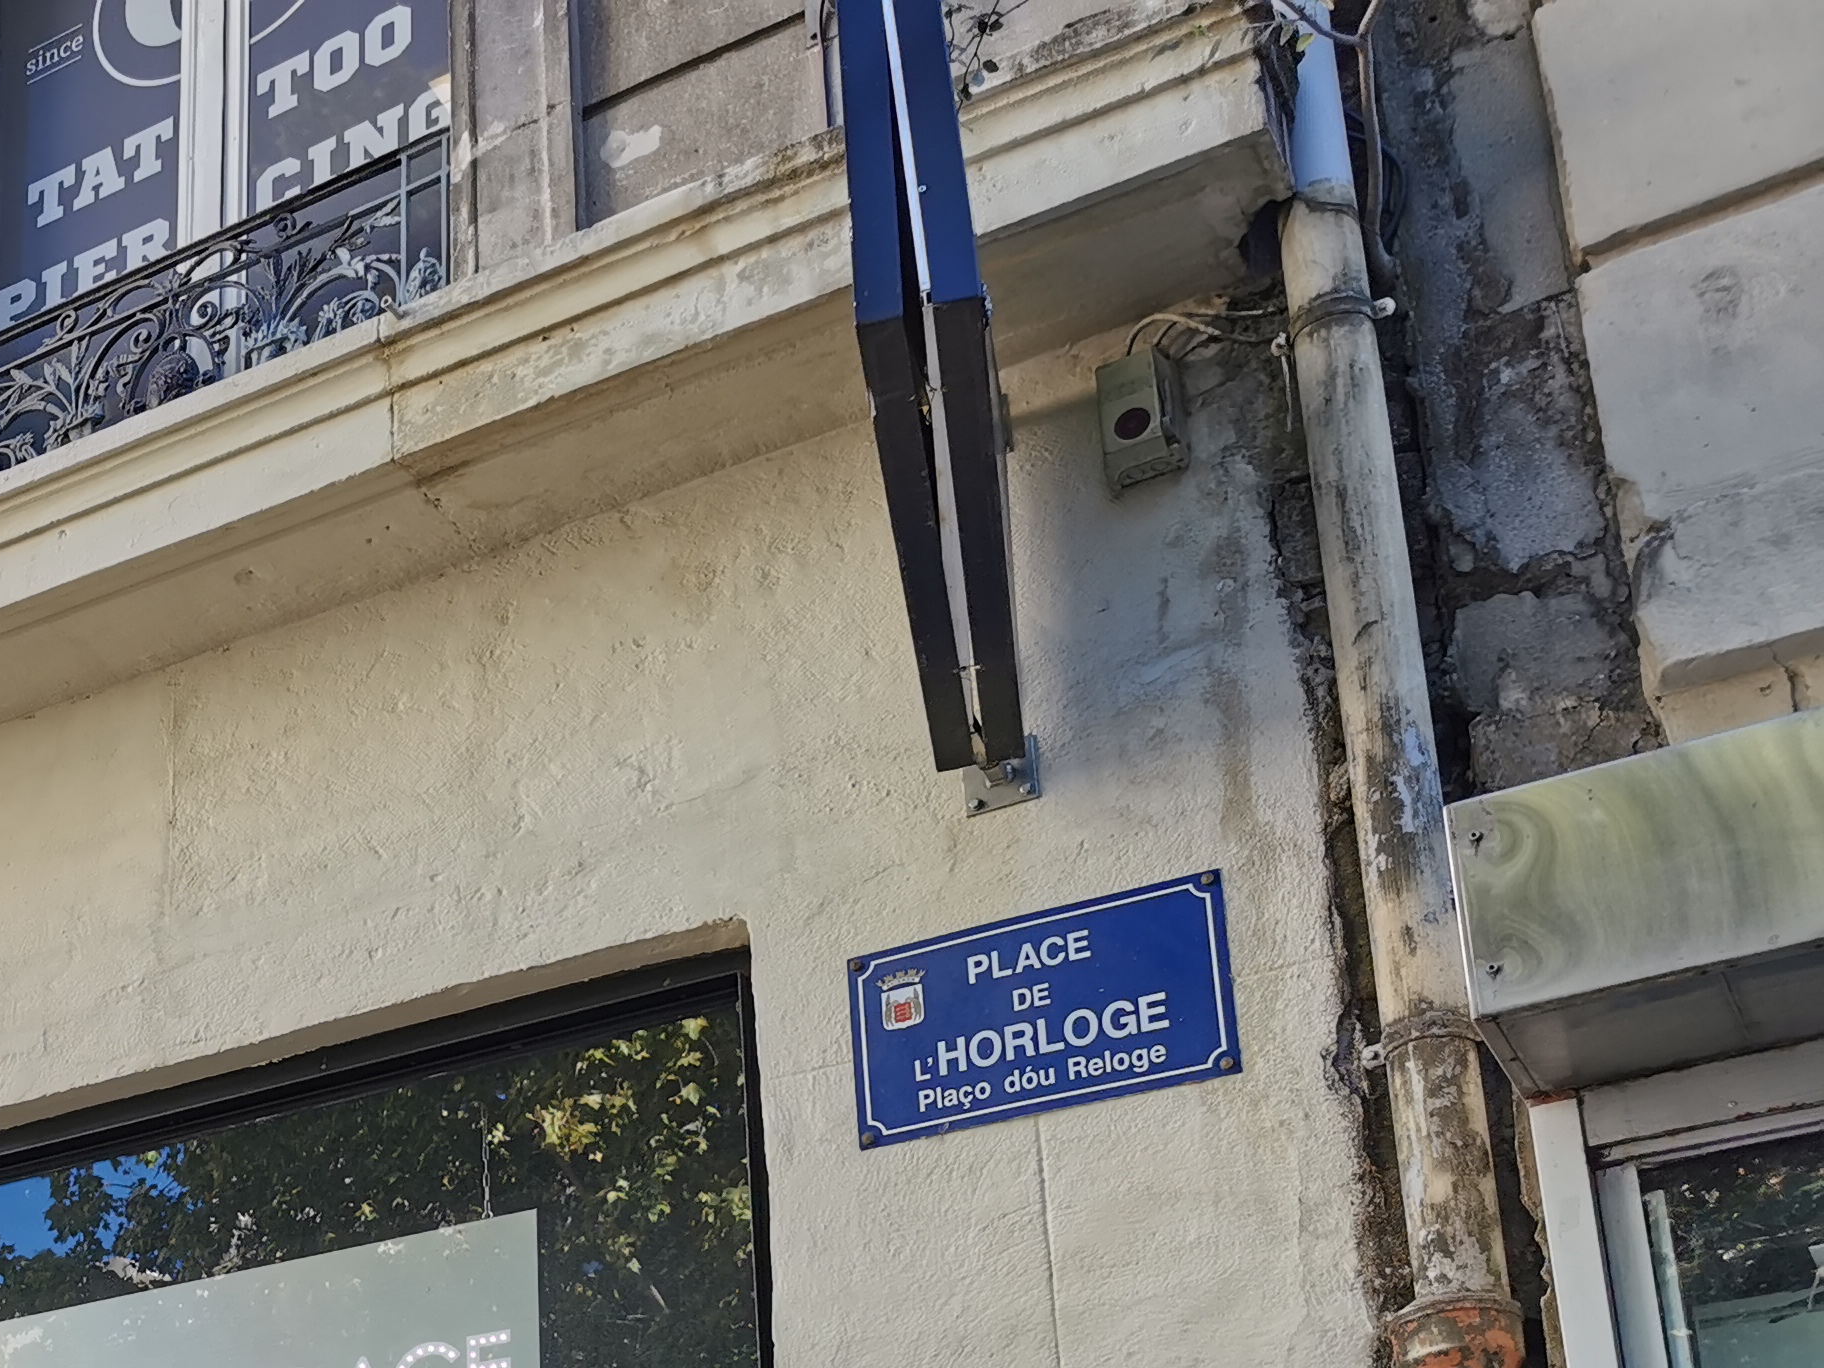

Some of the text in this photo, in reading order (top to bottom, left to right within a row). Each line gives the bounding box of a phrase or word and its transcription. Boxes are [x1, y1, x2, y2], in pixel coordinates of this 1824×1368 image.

[26, 34, 84, 76] since
[257, 4, 412, 119] TOO
[28, 116, 174, 228] TAT
[967, 930, 1091, 984] PLACE
[1012, 983, 1051, 1012] DE
[914, 992, 1170, 1082] L'HORLOGE
[918, 1044, 1167, 1112] Plaço dóu Reloge
